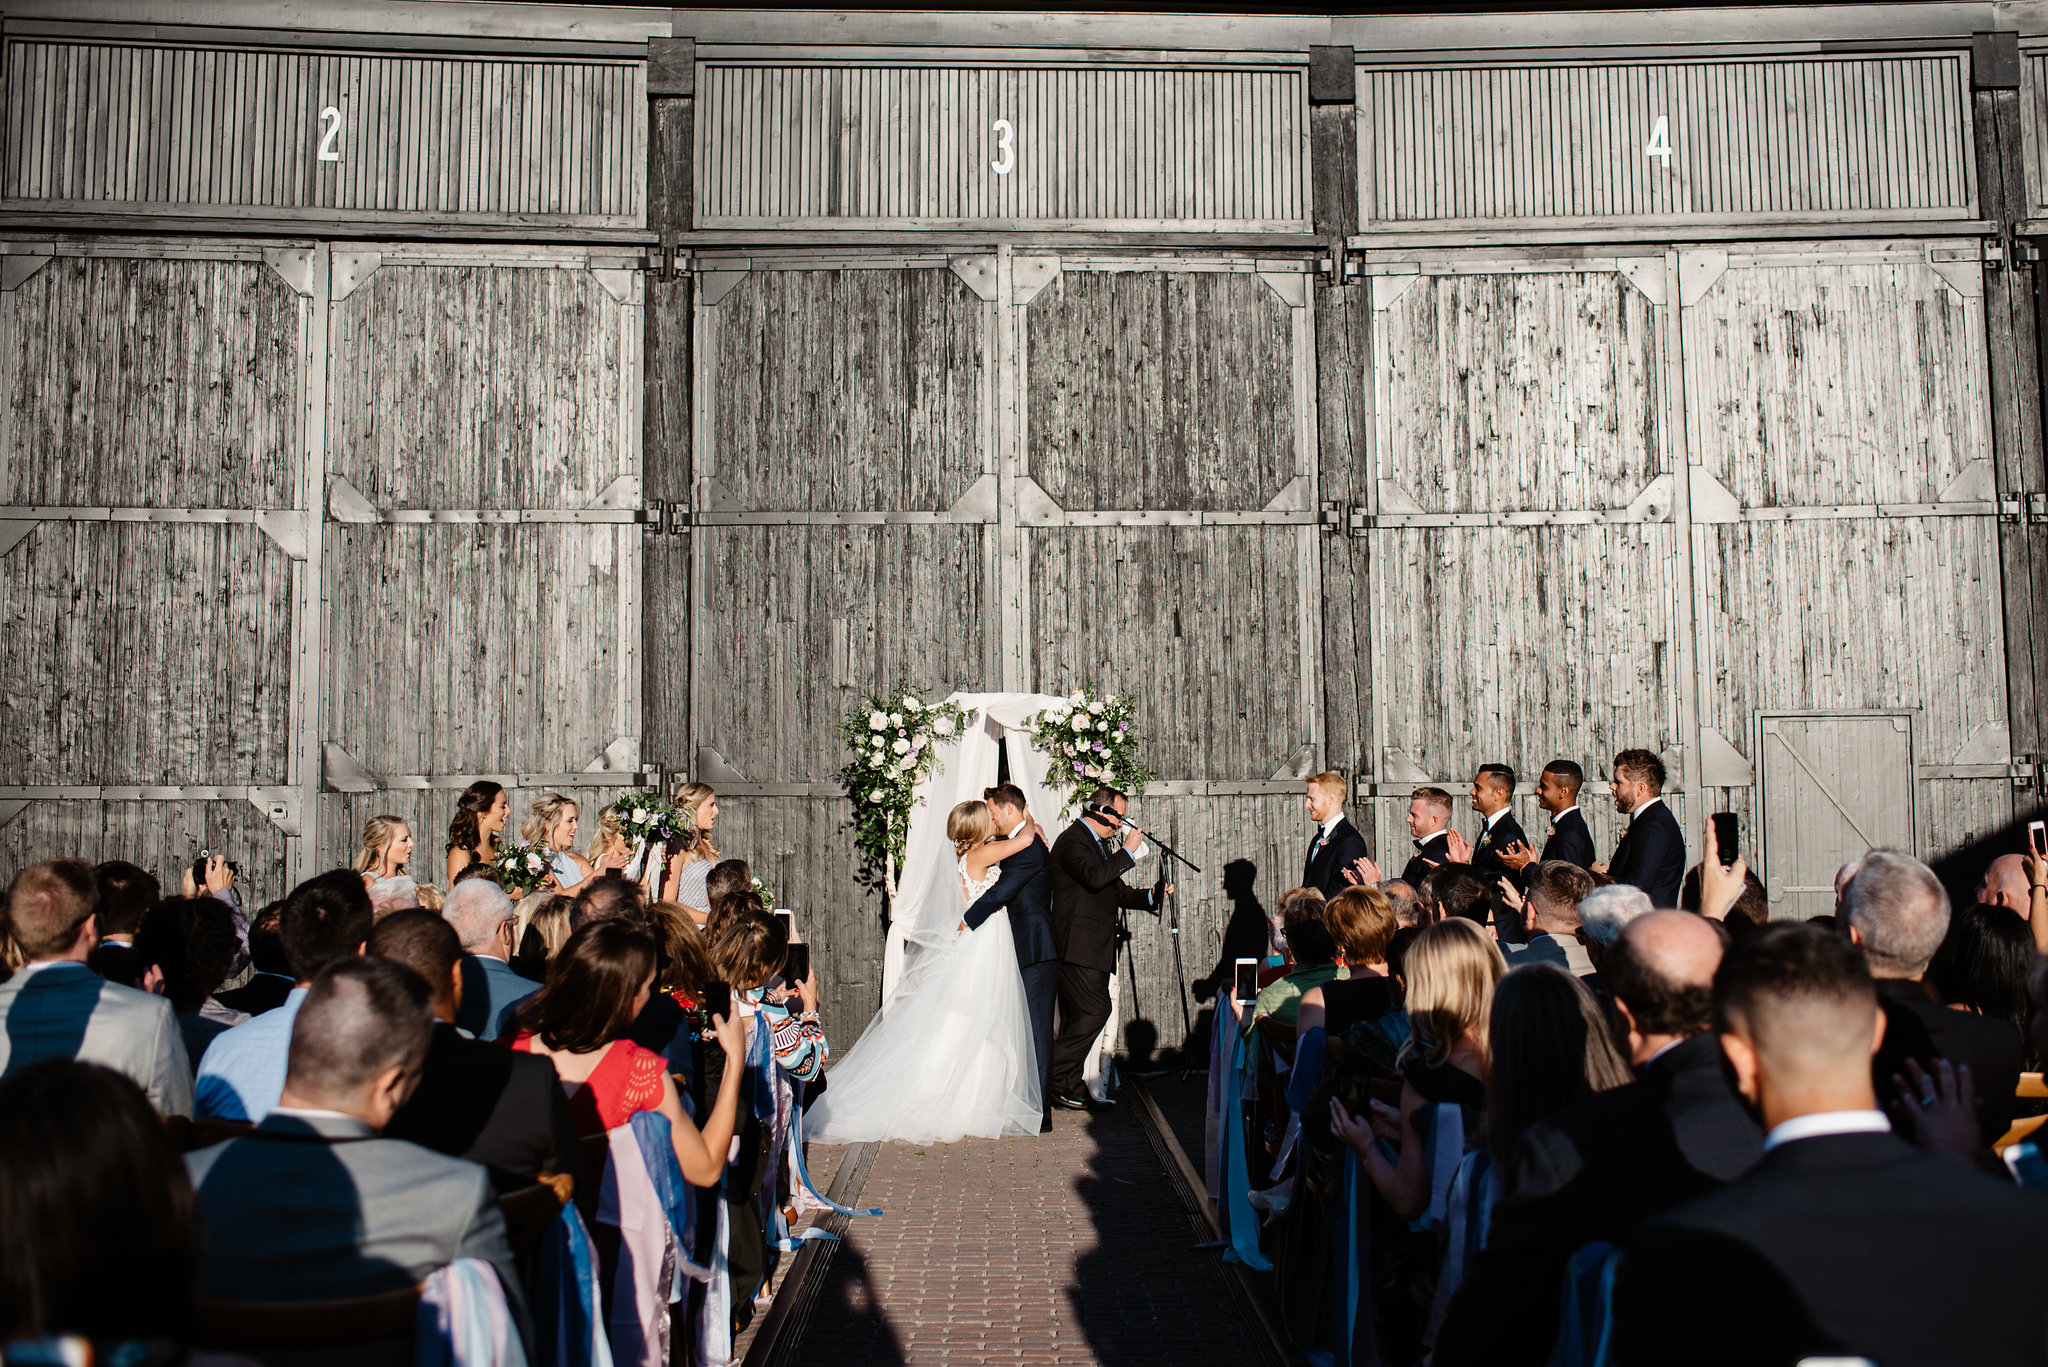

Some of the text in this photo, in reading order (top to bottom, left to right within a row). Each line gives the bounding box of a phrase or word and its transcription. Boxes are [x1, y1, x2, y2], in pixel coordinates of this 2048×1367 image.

[318, 106, 341, 161] 2
[991, 119, 1015, 175] 3
[1646, 115, 1673, 168] 4
